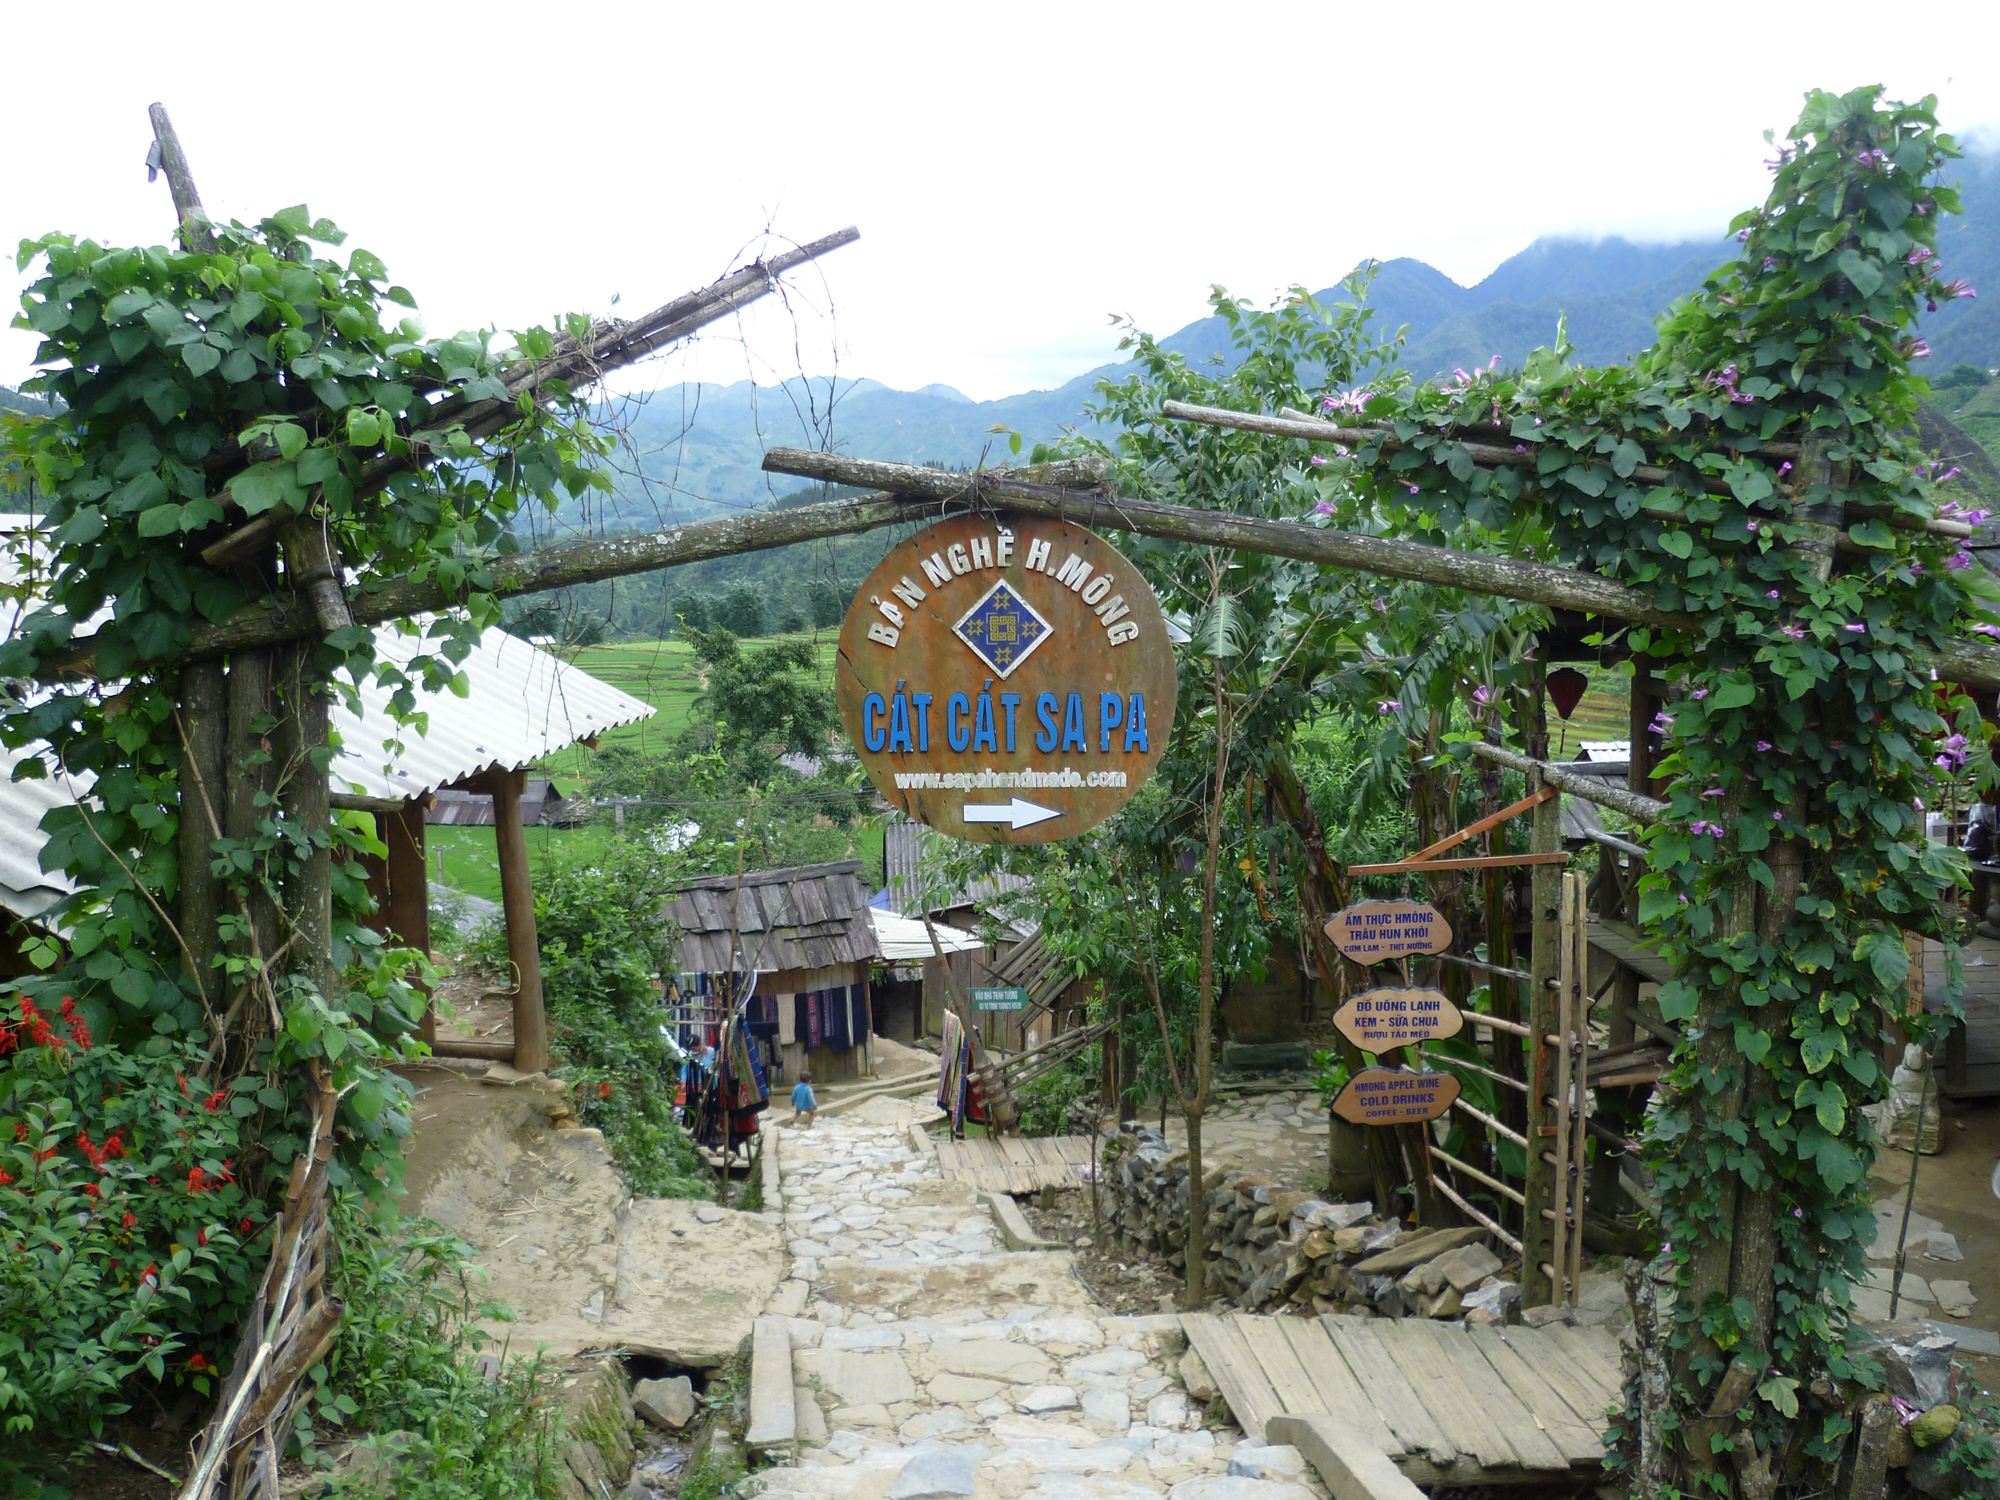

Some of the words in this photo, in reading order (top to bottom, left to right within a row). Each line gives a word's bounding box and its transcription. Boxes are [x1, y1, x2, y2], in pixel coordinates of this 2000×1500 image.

[867, 576, 927, 648] BẢN
[920, 525, 1014, 588] NGHỀ
[1025, 538, 1139, 647] H.MÔNG
[863, 680, 932, 752] CÁT
[947, 679, 1021, 752] CÁT
[1035, 691, 1087, 752] SA
[1099, 692, 1149, 752] PA
[894, 767, 1127, 792] www.sapahandmade.com
[1365, 913, 1392, 927] THỰC
[1395, 911, 1433, 924] HMÔNG
[1350, 928, 1376, 940] TRÂU
[1380, 929, 1401, 939] HUN
[1404, 926, 1428, 938] KHÓI
[1389, 944, 1405, 953] THỊT
[1407, 941, 1432, 950] NƯỚNG
[1375, 998, 1406, 1012] UỐNG
[1410, 1001, 1440, 1013] LẠNH
[1355, 1018, 1377, 1027] KEM
[1388, 1014, 1409, 1027] SỮA
[1412, 1016, 1439, 1027] CHUA
[1364, 1031, 1388, 1040] RƯỢU
[1391, 1030, 1408, 1039] TÁO
[1355, 1081, 1386, 1092] HMONG
[1388, 1080, 1414, 1091] APPLE
[1417, 1078, 1440, 1089] WINE
[1360, 1096, 1389, 1106] COLD
[1392, 1093, 1435, 1104] DRINKS
[1366, 1109, 1398, 1117] COFFEE
[1406, 1107, 1429, 1115] BEER
